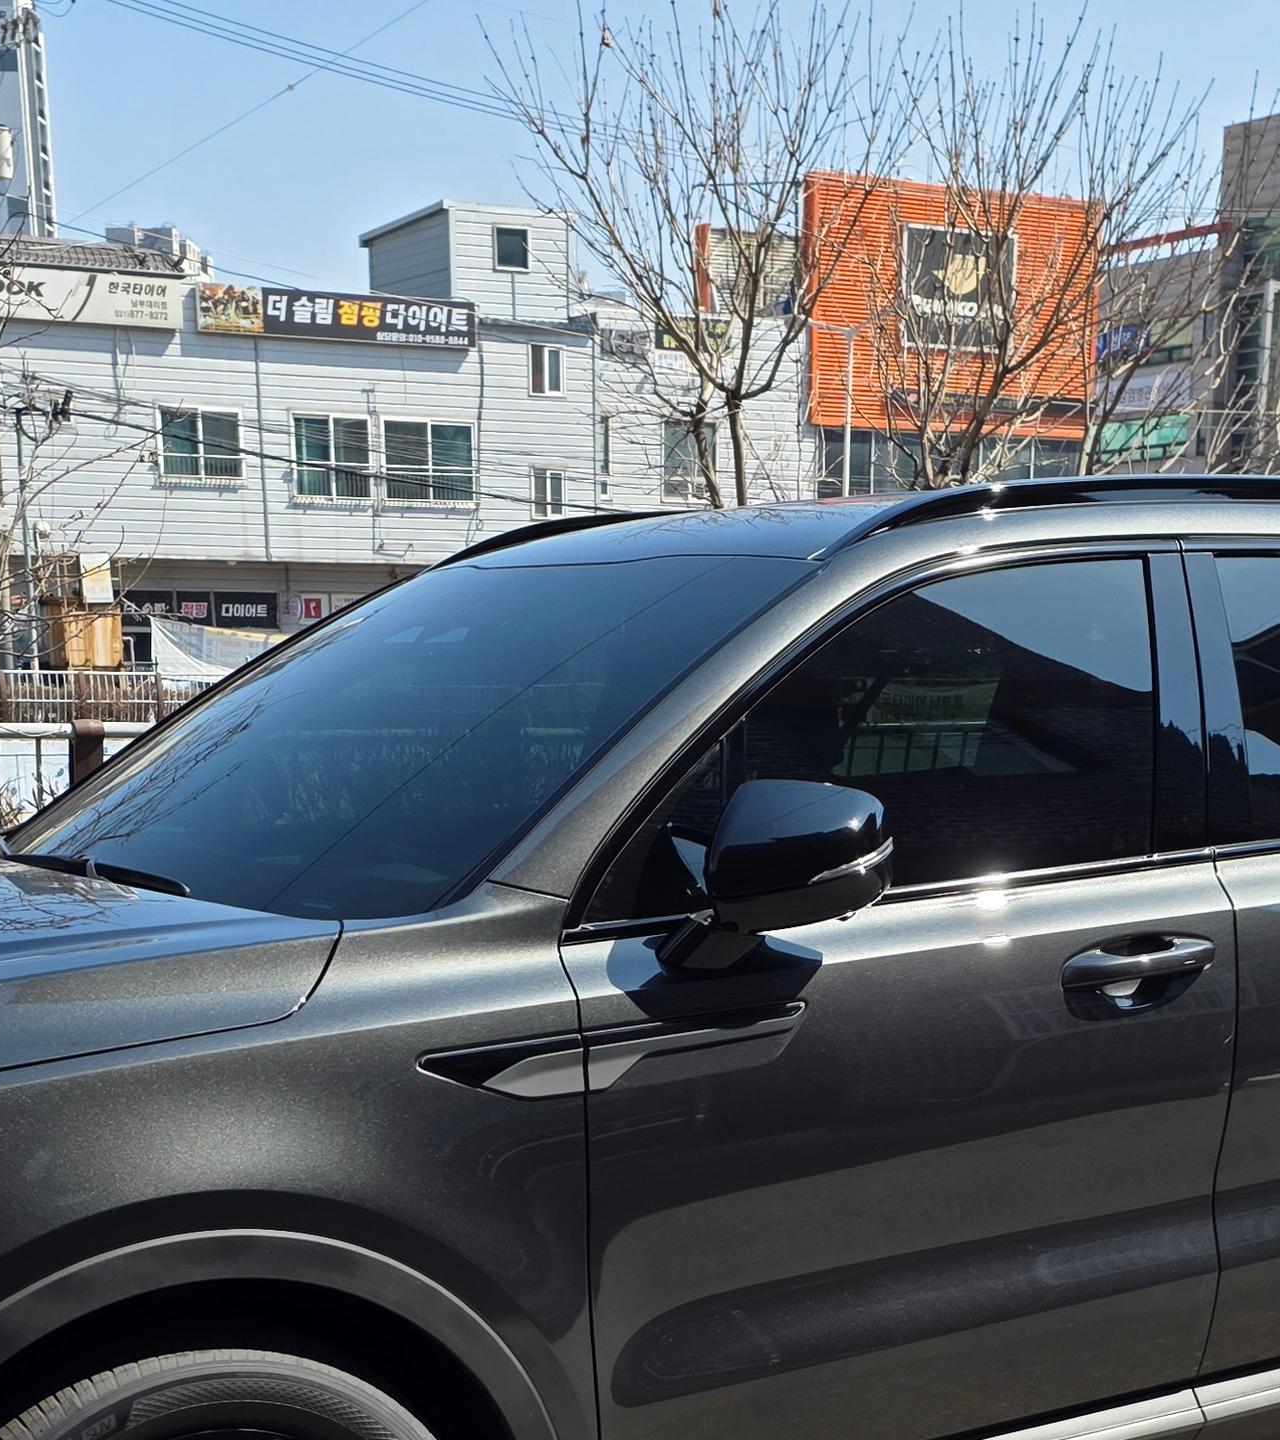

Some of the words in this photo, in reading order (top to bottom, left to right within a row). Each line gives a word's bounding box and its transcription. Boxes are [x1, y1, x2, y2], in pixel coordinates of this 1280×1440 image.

[108, 281, 167, 298] 한국타이어
[266, 295, 287, 321] 더
[292, 295, 335, 325] 슬림
[337, 300, 383, 328] 점핑
[385, 303, 469, 333] 다이어트
[221, 603, 268, 618] 다이어트
